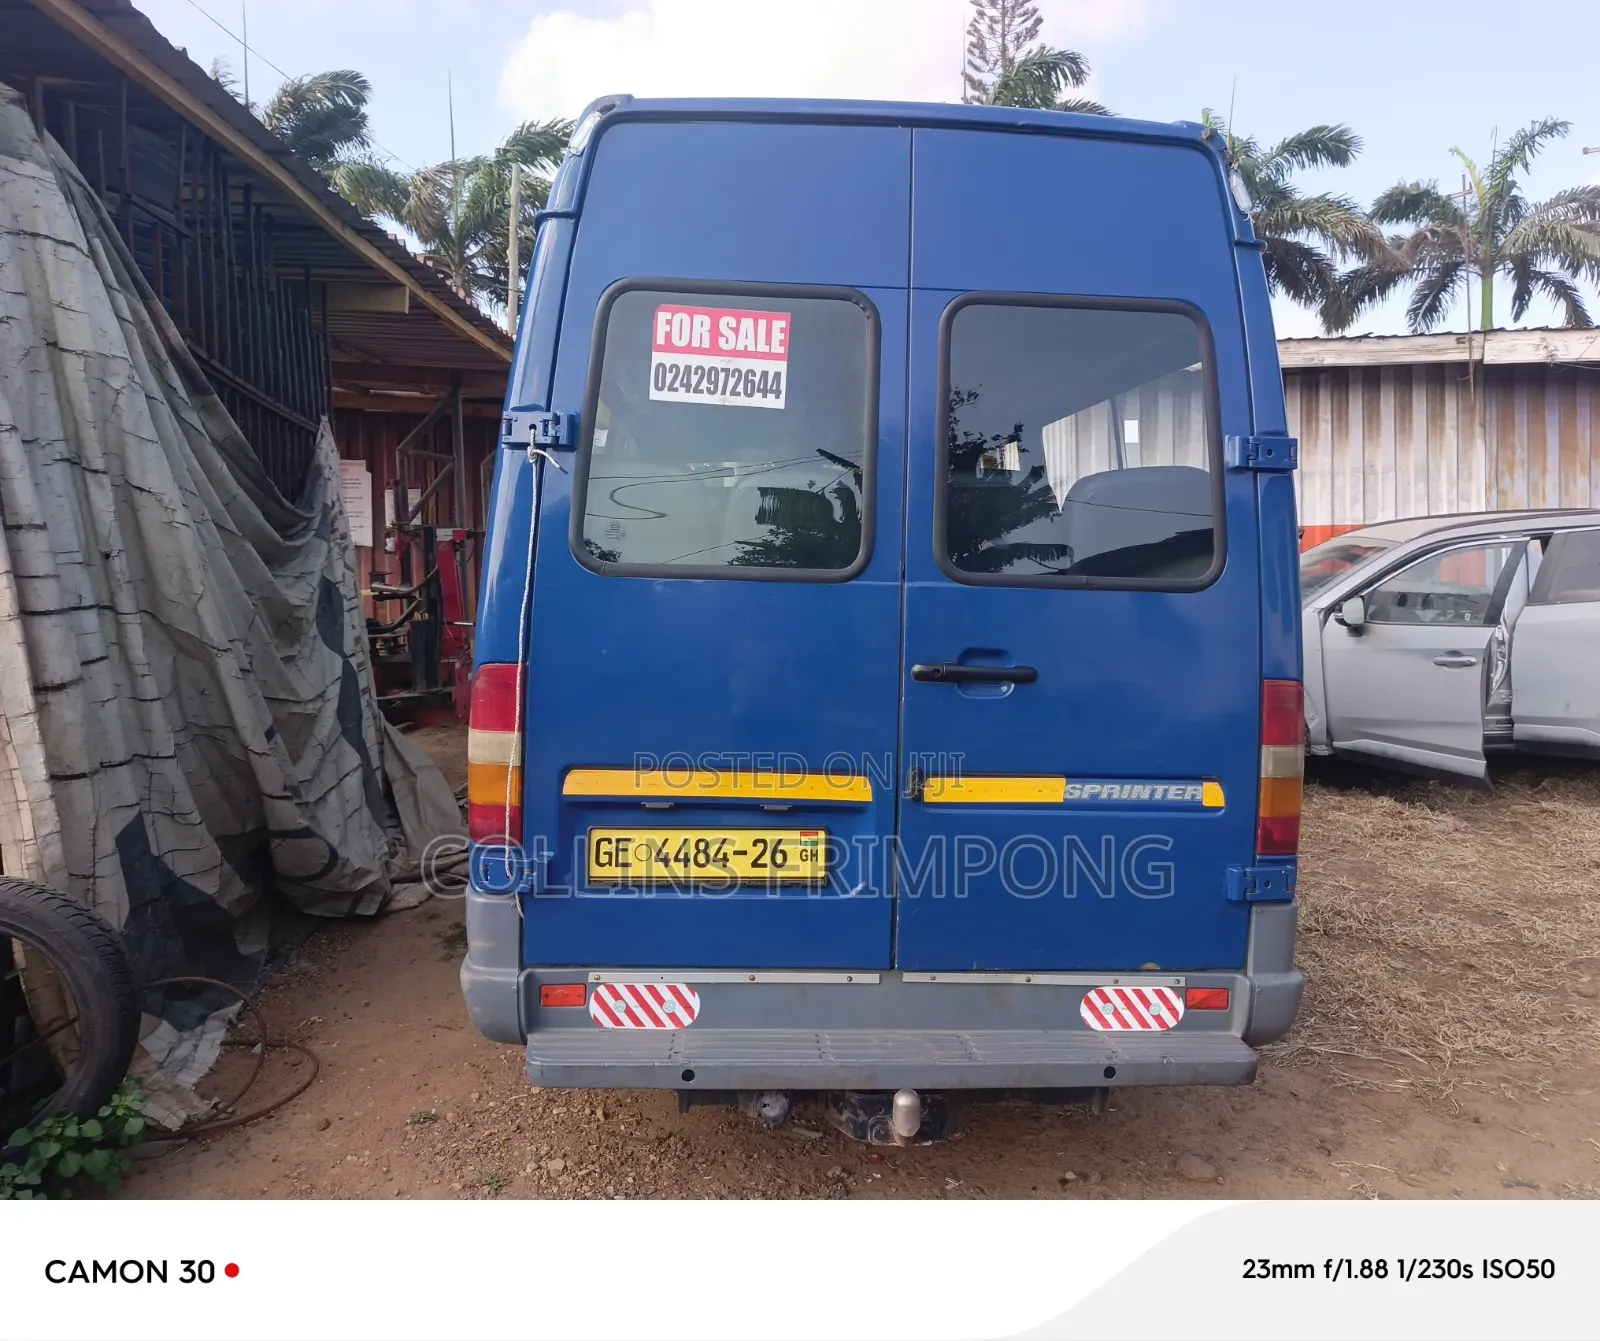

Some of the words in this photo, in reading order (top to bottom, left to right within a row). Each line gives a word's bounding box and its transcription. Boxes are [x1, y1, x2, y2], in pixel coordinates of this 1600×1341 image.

[656, 312, 711, 349] FOR
[718, 315, 786, 354] SALE
[653, 362, 782, 400] 0242972644
[1064, 783, 1203, 801] SPRINTER
[594, 837, 632, 868] GE
[653, 838, 788, 869] 4484-26
[799, 848, 819, 863] GH
